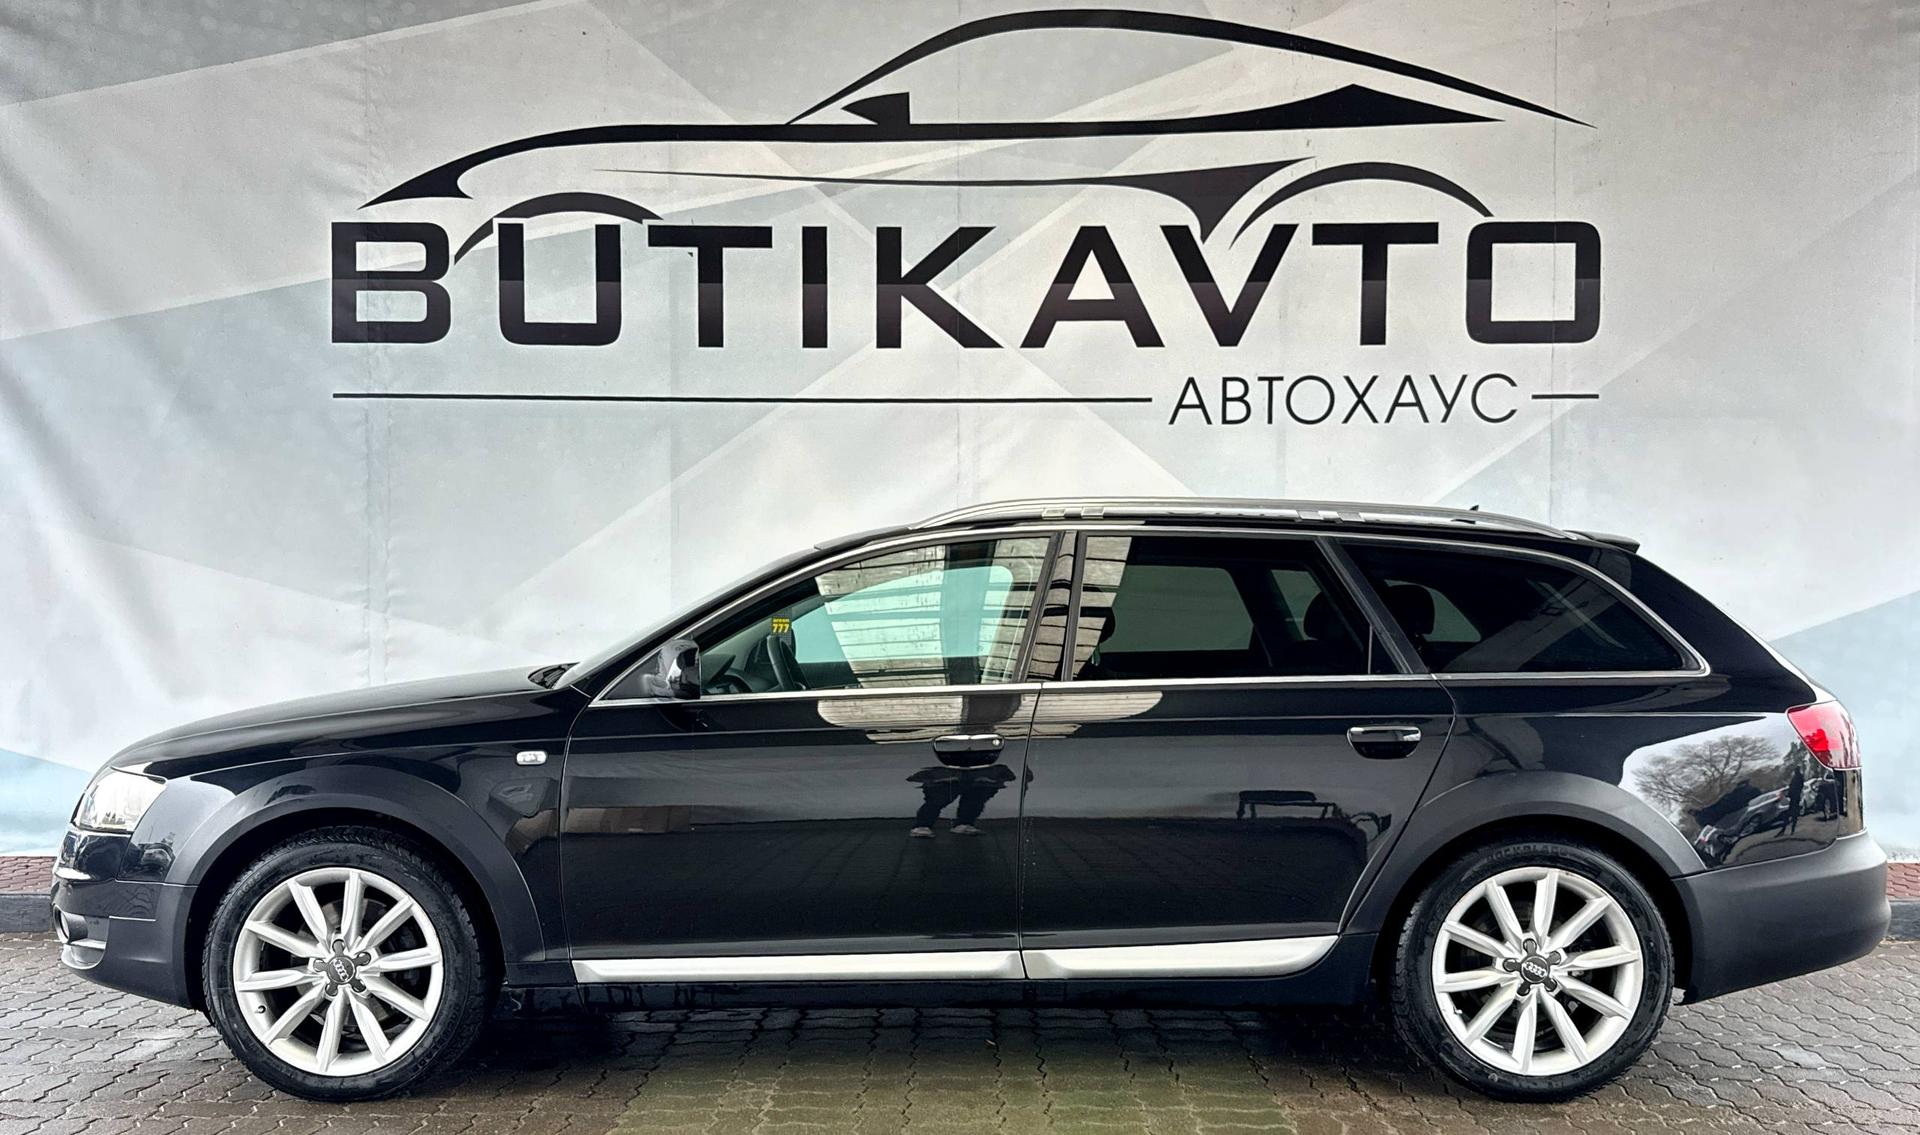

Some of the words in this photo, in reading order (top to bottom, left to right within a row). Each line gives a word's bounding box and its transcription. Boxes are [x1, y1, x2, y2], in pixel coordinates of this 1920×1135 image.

[331, 221, 1601, 349] BUTIKAVTO
[1168, 373, 1519, 426] АВТОХАУС
[772, 623, 790, 633] 777
